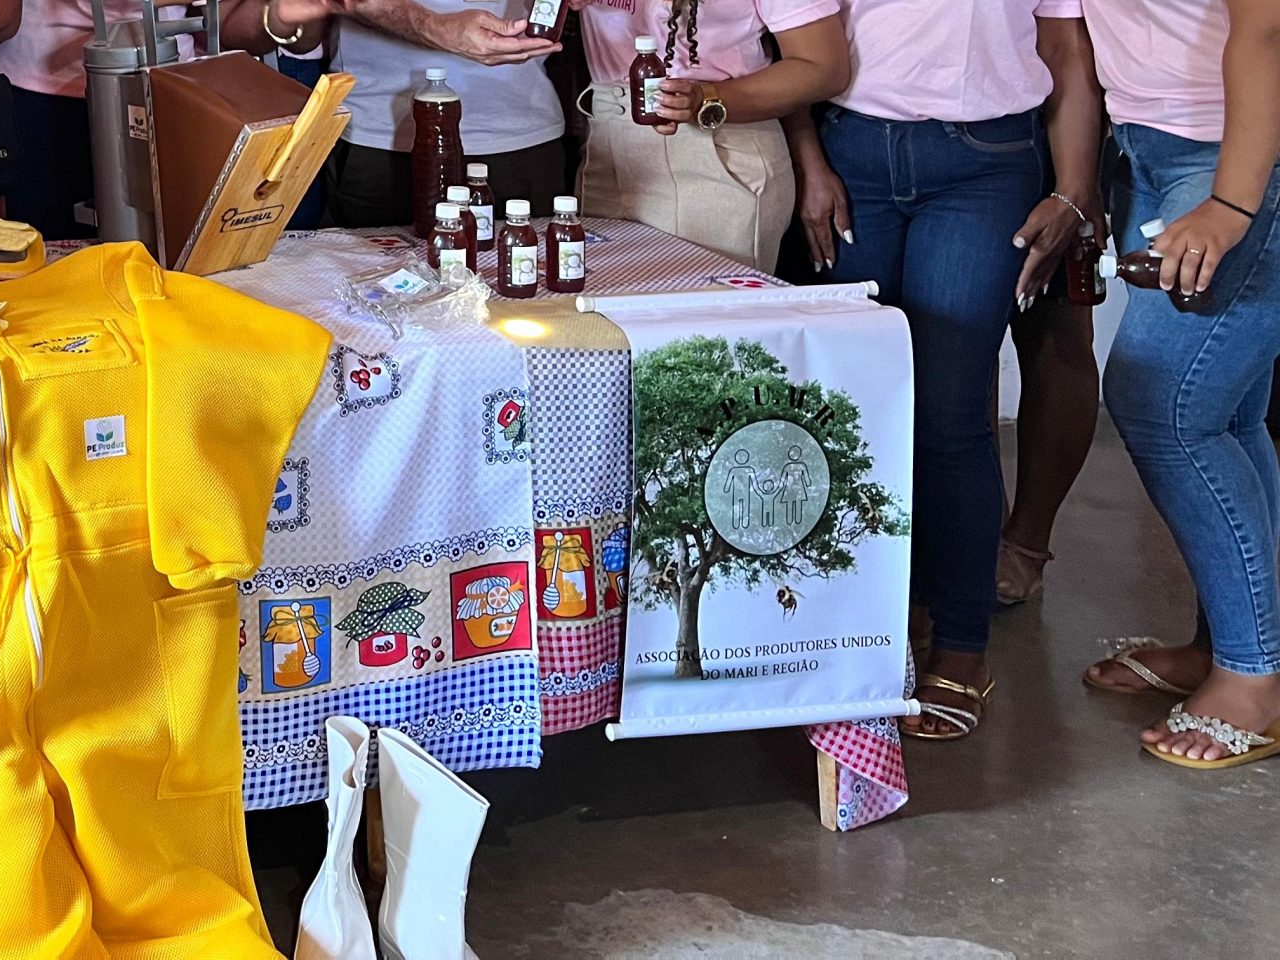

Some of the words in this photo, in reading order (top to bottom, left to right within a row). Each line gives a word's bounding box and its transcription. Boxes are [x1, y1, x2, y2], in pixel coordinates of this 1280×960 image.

[86, 444, 97, 453] PE
[725, 646, 751, 661] DOS
[755, 638, 837, 657] PRODUTORES
[841, 634, 891, 649] UNIDOS
[701, 667, 721, 681] DO
[724, 666, 758, 680] MARI
[762, 664, 769, 676] E
[772, 658, 819, 675] REGIÃO
